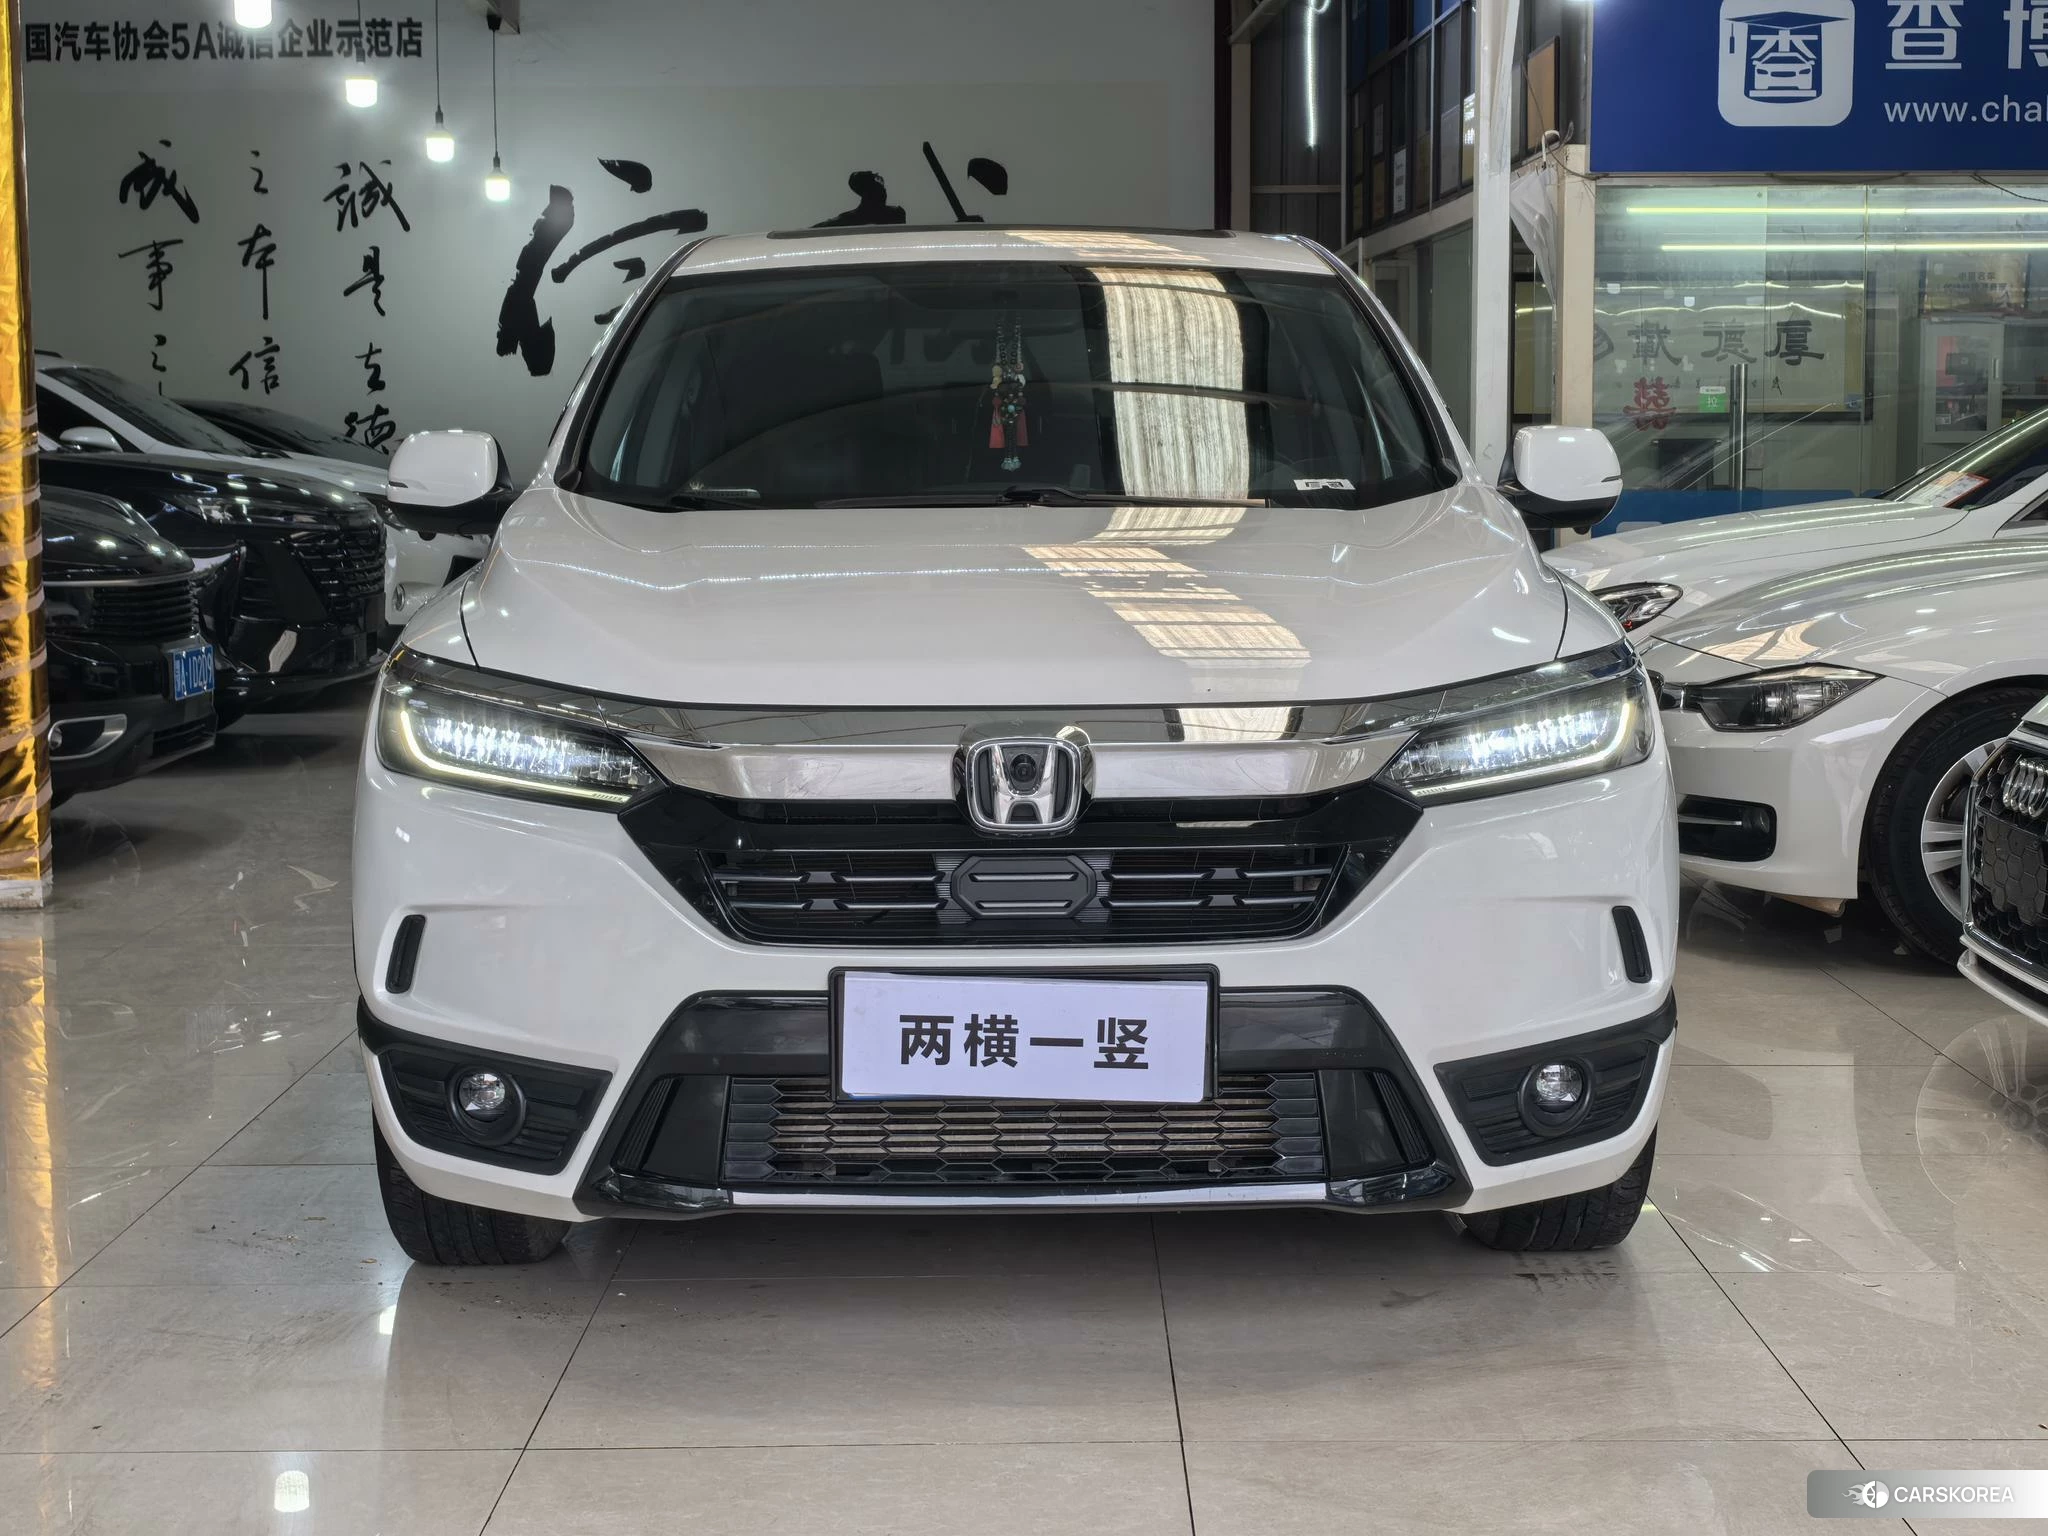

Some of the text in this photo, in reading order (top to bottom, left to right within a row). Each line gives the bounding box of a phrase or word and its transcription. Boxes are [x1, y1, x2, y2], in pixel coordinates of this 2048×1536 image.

[1884, 94, 2048, 122] www.cha
[899, 1013, 1149, 1070] 两横一竖
